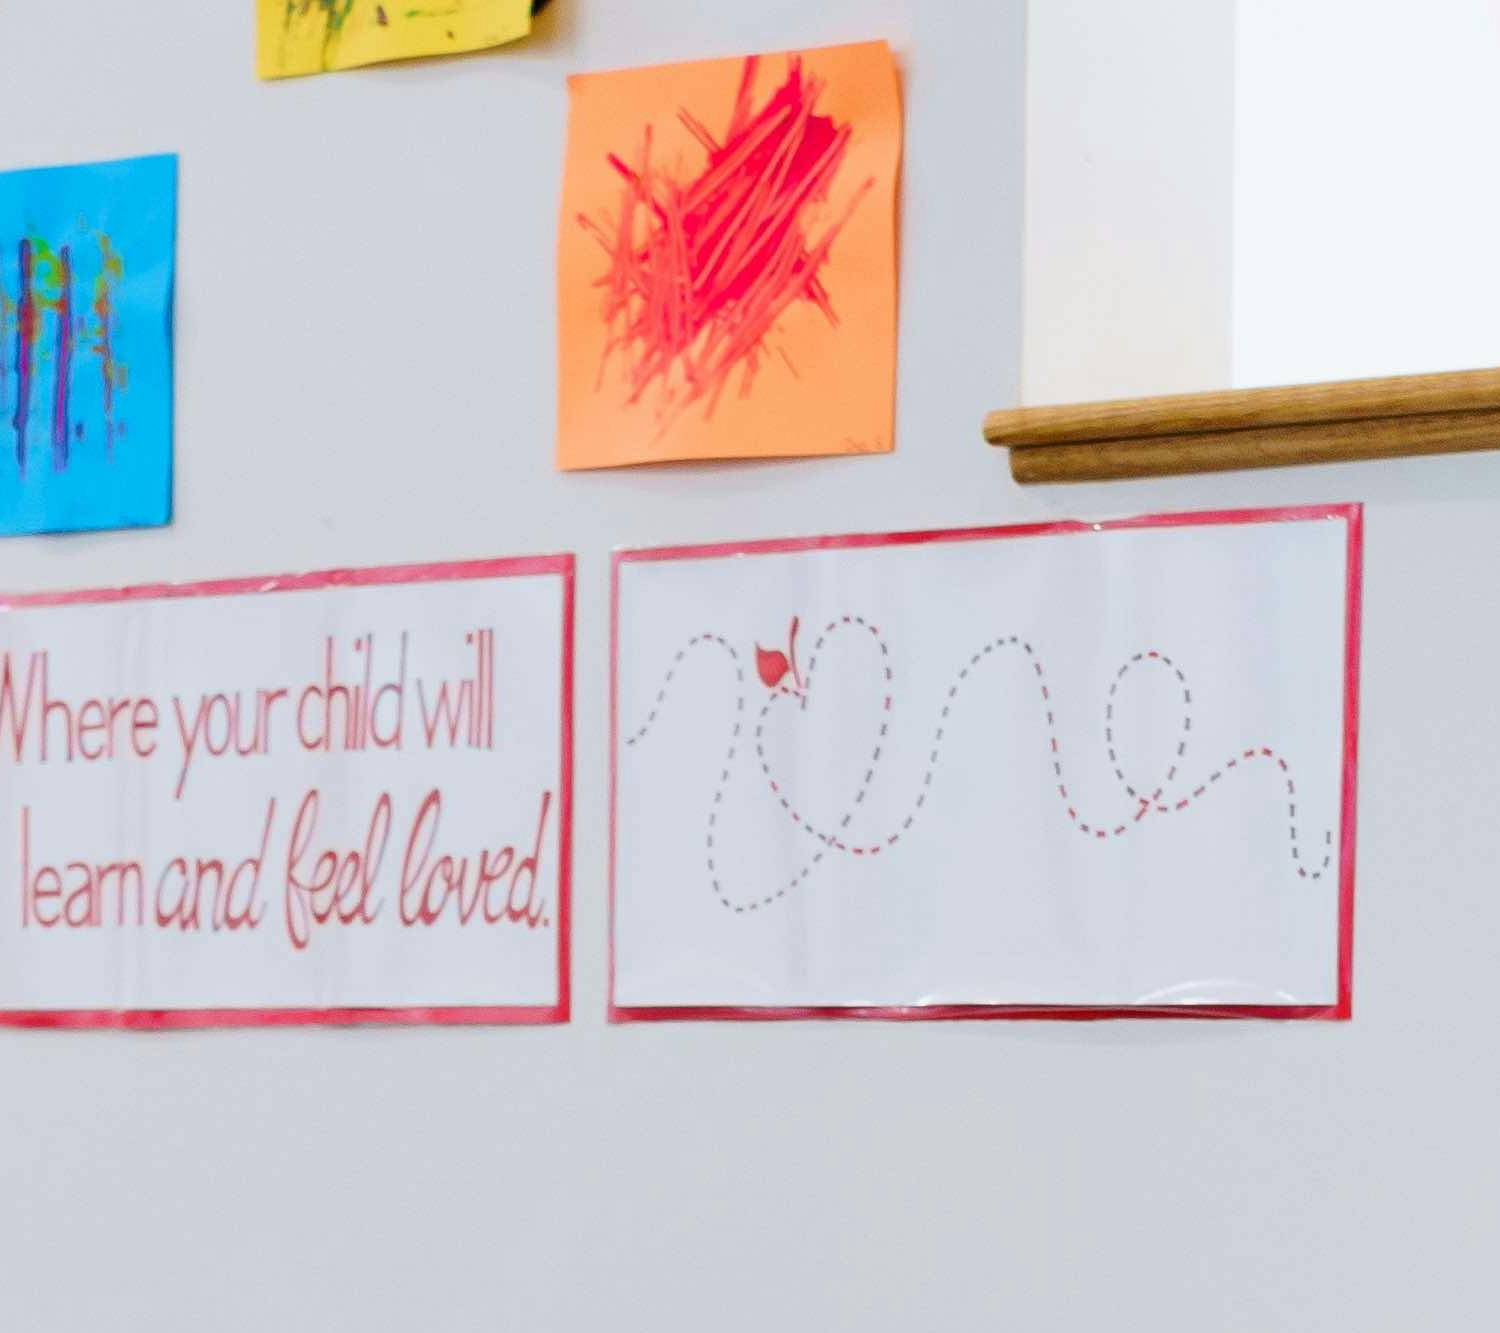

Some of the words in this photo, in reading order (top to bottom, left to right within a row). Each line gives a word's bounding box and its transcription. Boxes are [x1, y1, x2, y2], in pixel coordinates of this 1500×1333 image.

[172, 688, 288, 800] your
[297, 630, 408, 752] child
[418, 628, 494, 750] will
[21, 806, 142, 927] learn
[155, 798, 275, 932] and
[286, 789, 392, 949] feel
[401, 788, 552, 927] loved.
